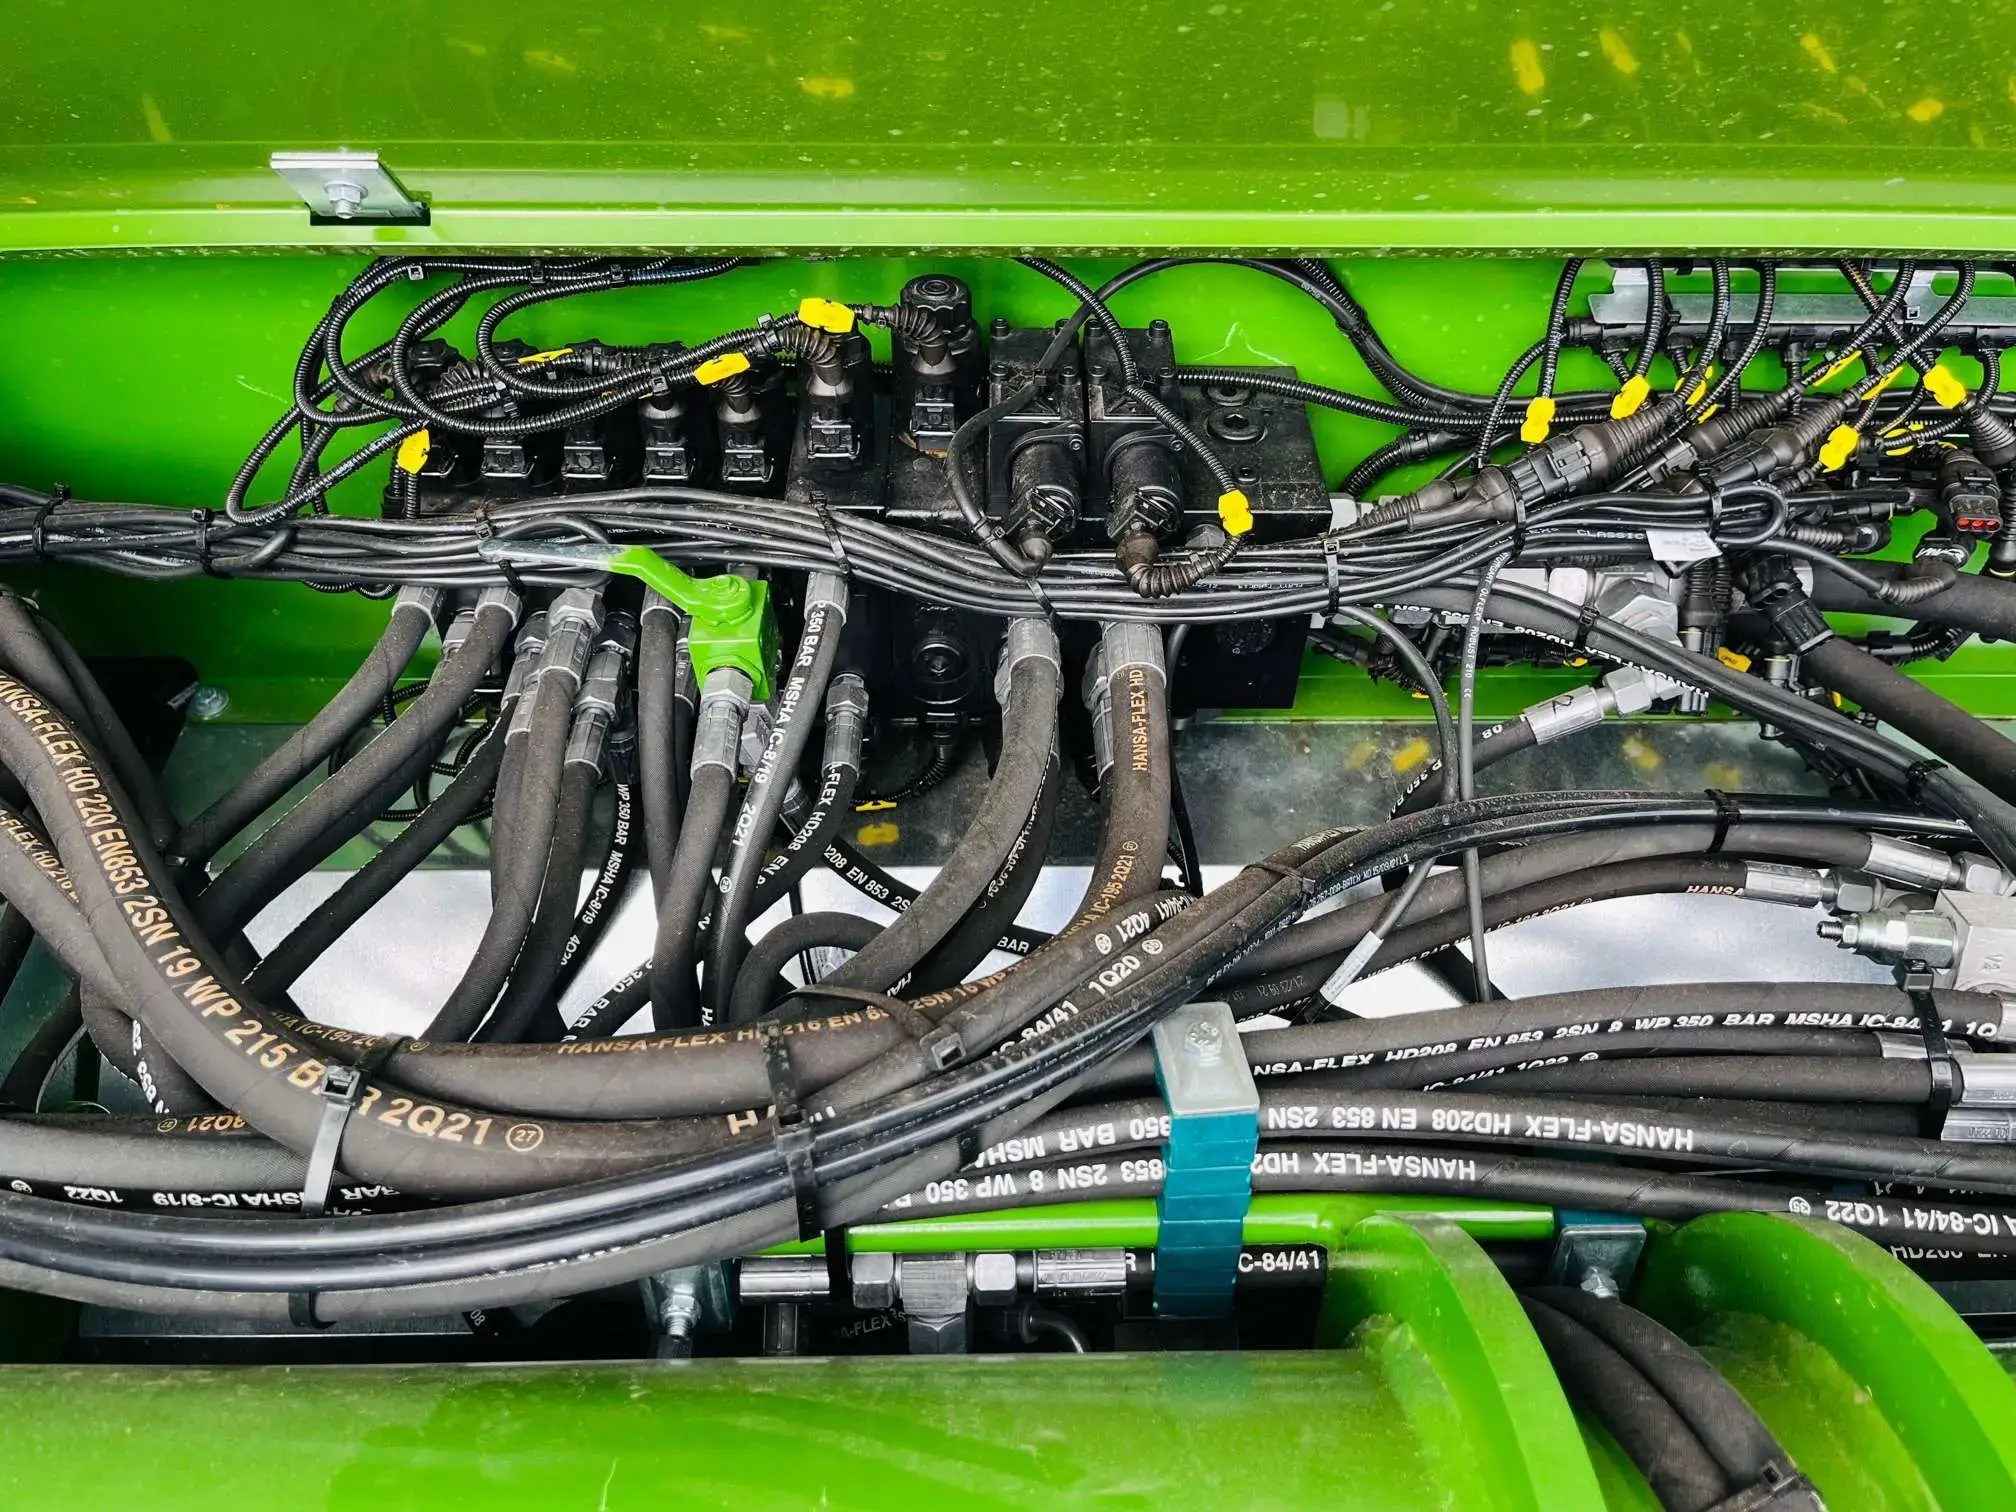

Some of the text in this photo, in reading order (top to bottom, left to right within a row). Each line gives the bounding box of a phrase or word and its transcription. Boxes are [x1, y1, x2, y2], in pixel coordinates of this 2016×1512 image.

[807, 610, 825, 633] 350
[797, 636, 819, 667] BAR
[776, 676, 805, 725] MSHA
[0, 675, 88, 766] ANSA-FLEX
[1129, 669, 1149, 772] HANSA-FLEX HD
[754, 727, 788, 783] IC-8/19
[62, 766, 101, 793] HD
[616, 783, 631, 800] WP
[76, 793, 118, 828] 220
[618, 800, 631, 819] 350
[614, 819, 630, 846] BAR
[732, 803, 756, 847] 2Q21
[788, 811, 826, 850] HD208
[91, 828, 149, 895] EN853
[601, 850, 624, 885] MSHA
[764, 855, 789, 876] EN
[1111, 855, 1135, 881] 2Q21
[823, 844, 911, 911] 208 EN 853 2S
[582, 885, 610, 925] IC-8/19
[123, 895, 180, 947] 2SN
[1116, 911, 1151, 943] 4Q21
[996, 936, 1030, 953] BAR
[157, 945, 201, 977] 19
[1088, 955, 1141, 996] 1Q20
[183, 975, 242, 1018] WP
[557, 1031, 727, 1054] HANSA-FLEX
[783, 1020, 821, 1036] 216
[827, 1011, 862, 1028] EN
[912, 992, 952, 1010] 2SN
[574, 997, 610, 1029] BAR
[224, 1019, 298, 1069] 215
[1253, 1053, 1374, 1077] NSA-FLEX
[1467, 1035, 1502, 1051] EN
[1552, 1022, 1600, 1039] 2SN
[1633, 1015, 1673, 1031] WP
[1673, 1015, 1714, 1029] 350
[1721, 1012, 1776, 1027] BAR
[1784, 1012, 1853, 1028] MSHA
[1858, 1013, 1954, 1033] IC-841
[287, 1058, 383, 1116] BR
[378, 1097, 493, 1145] 2Q21
[1129, 1114, 1171, 1139] 350
[1267, 1105, 1319, 1129] 2SN
[1331, 1105, 1377, 1129] 853
[1381, 1107, 1417, 1131] EN
[1431, 1109, 1512, 1135] HD208
[1059, 1122, 1117, 1150] BAR
[1524, 1115, 1694, 1151] HANSA-FLEX
[1057, 1163, 1109, 1190] 2SN
[1120, 1158, 1164, 1183] 853
[1250, 1152, 1299, 1175] HD2
[1312, 1151, 1476, 1181] HANSA-FLEX
[64, 1185, 124, 1203] 1Q22
[925, 1178, 969, 1201] 350
[975, 1173, 1017, 1198] WP
[1029, 1169, 1044, 1191] 8
[152, 1192, 244, 1208] IC-8/19
[251, 1191, 305, 1208] SHA
[1825, 1200, 1889, 1225] 1Q22
[1902, 1206, 2001, 1235] IC-84/41
[1238, 1249, 1320, 1273] C-84/41
